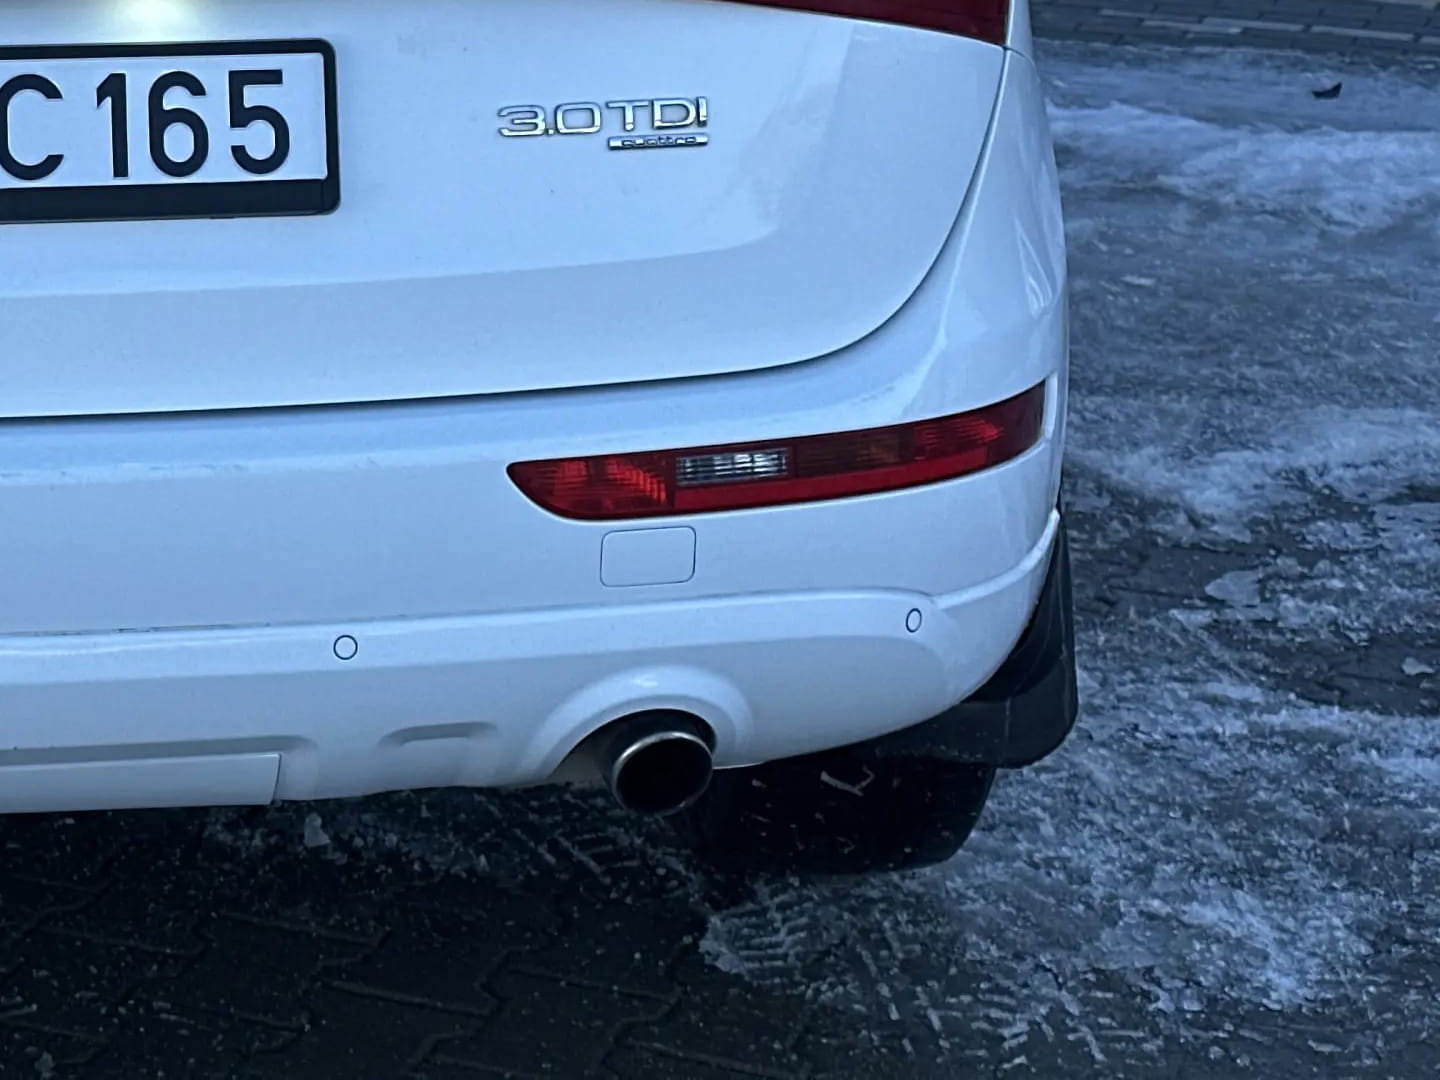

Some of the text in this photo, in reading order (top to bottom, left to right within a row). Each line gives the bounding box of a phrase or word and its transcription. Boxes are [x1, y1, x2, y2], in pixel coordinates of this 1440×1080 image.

[96, 69, 291, 178] 165
[497, 96, 708, 137] 3.0 TDI
[620, 135, 698, 150] quattro
